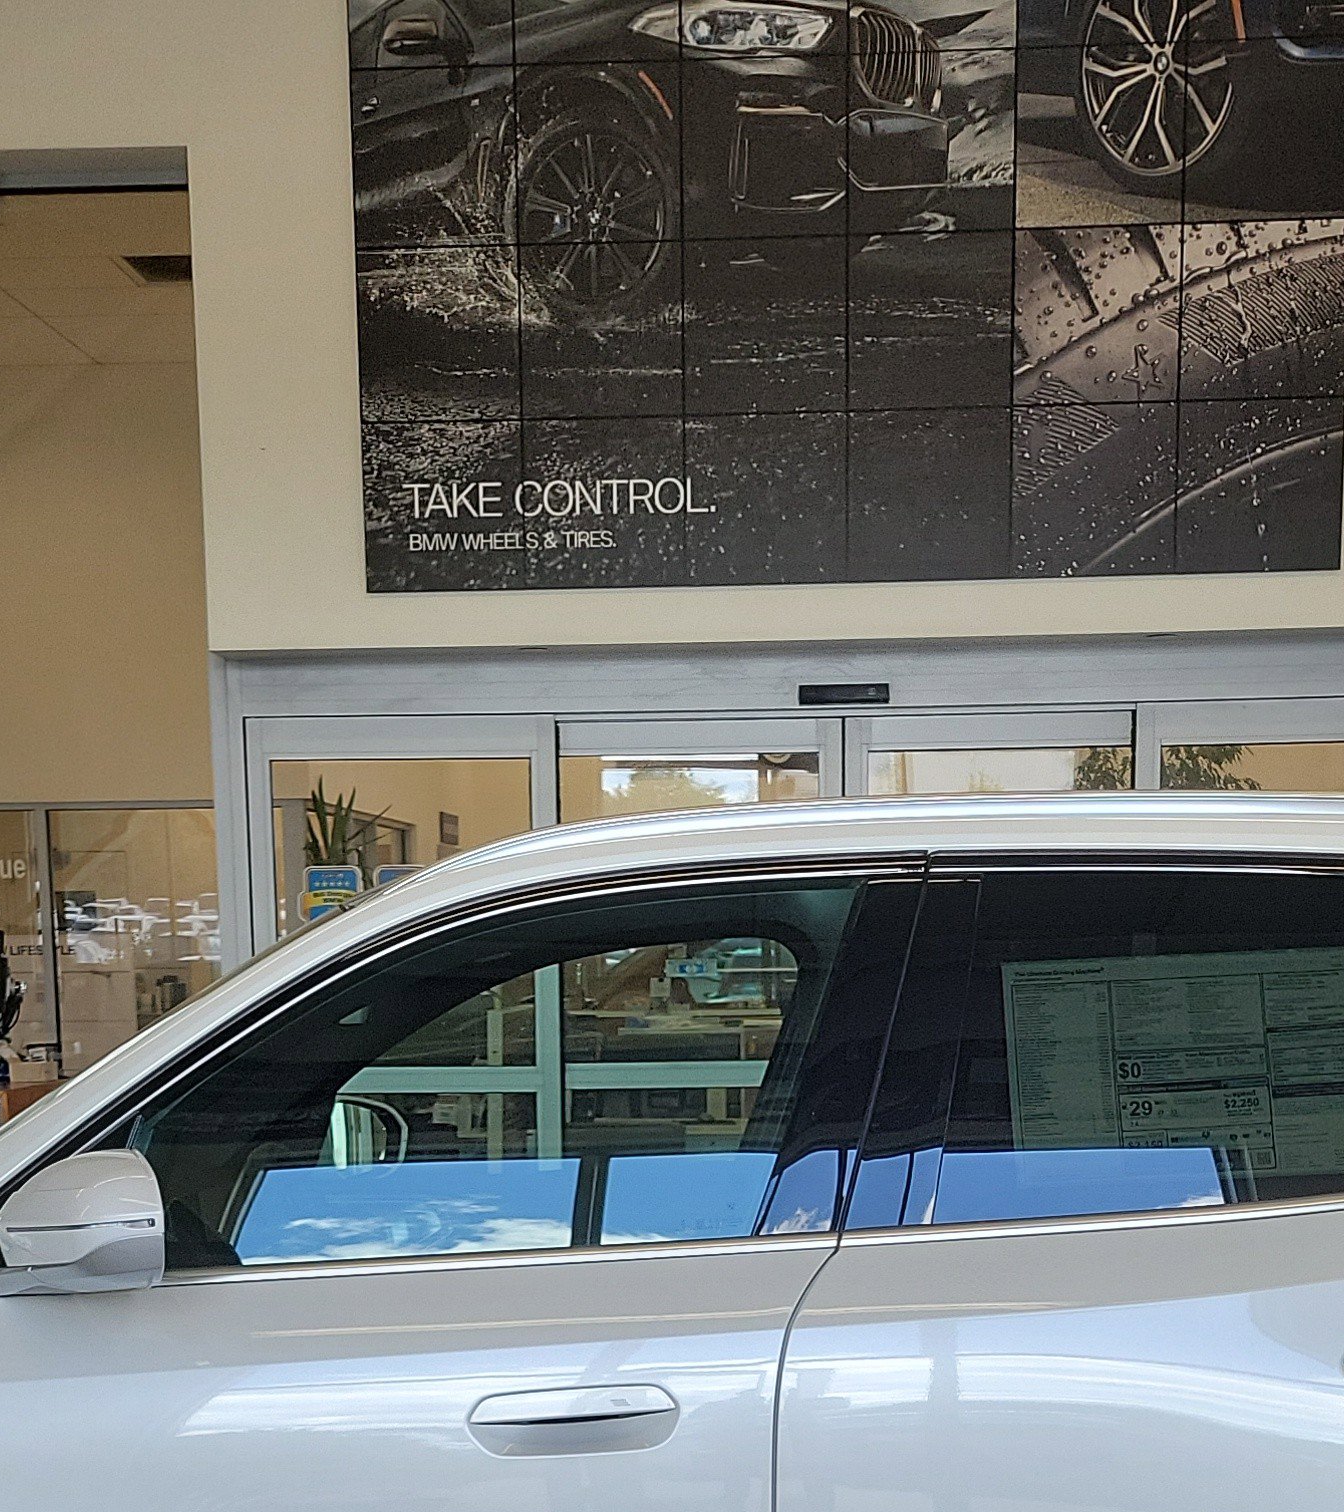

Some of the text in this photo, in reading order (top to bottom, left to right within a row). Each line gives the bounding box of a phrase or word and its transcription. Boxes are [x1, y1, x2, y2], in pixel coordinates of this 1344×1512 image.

[402, 477, 716, 518] TAKE CONTROL.
[409, 530, 617, 551] BMW WHEELS & TIRES.
[1118, 1062, 1142, 1080] $0
[1129, 1101, 1153, 1117] 29
